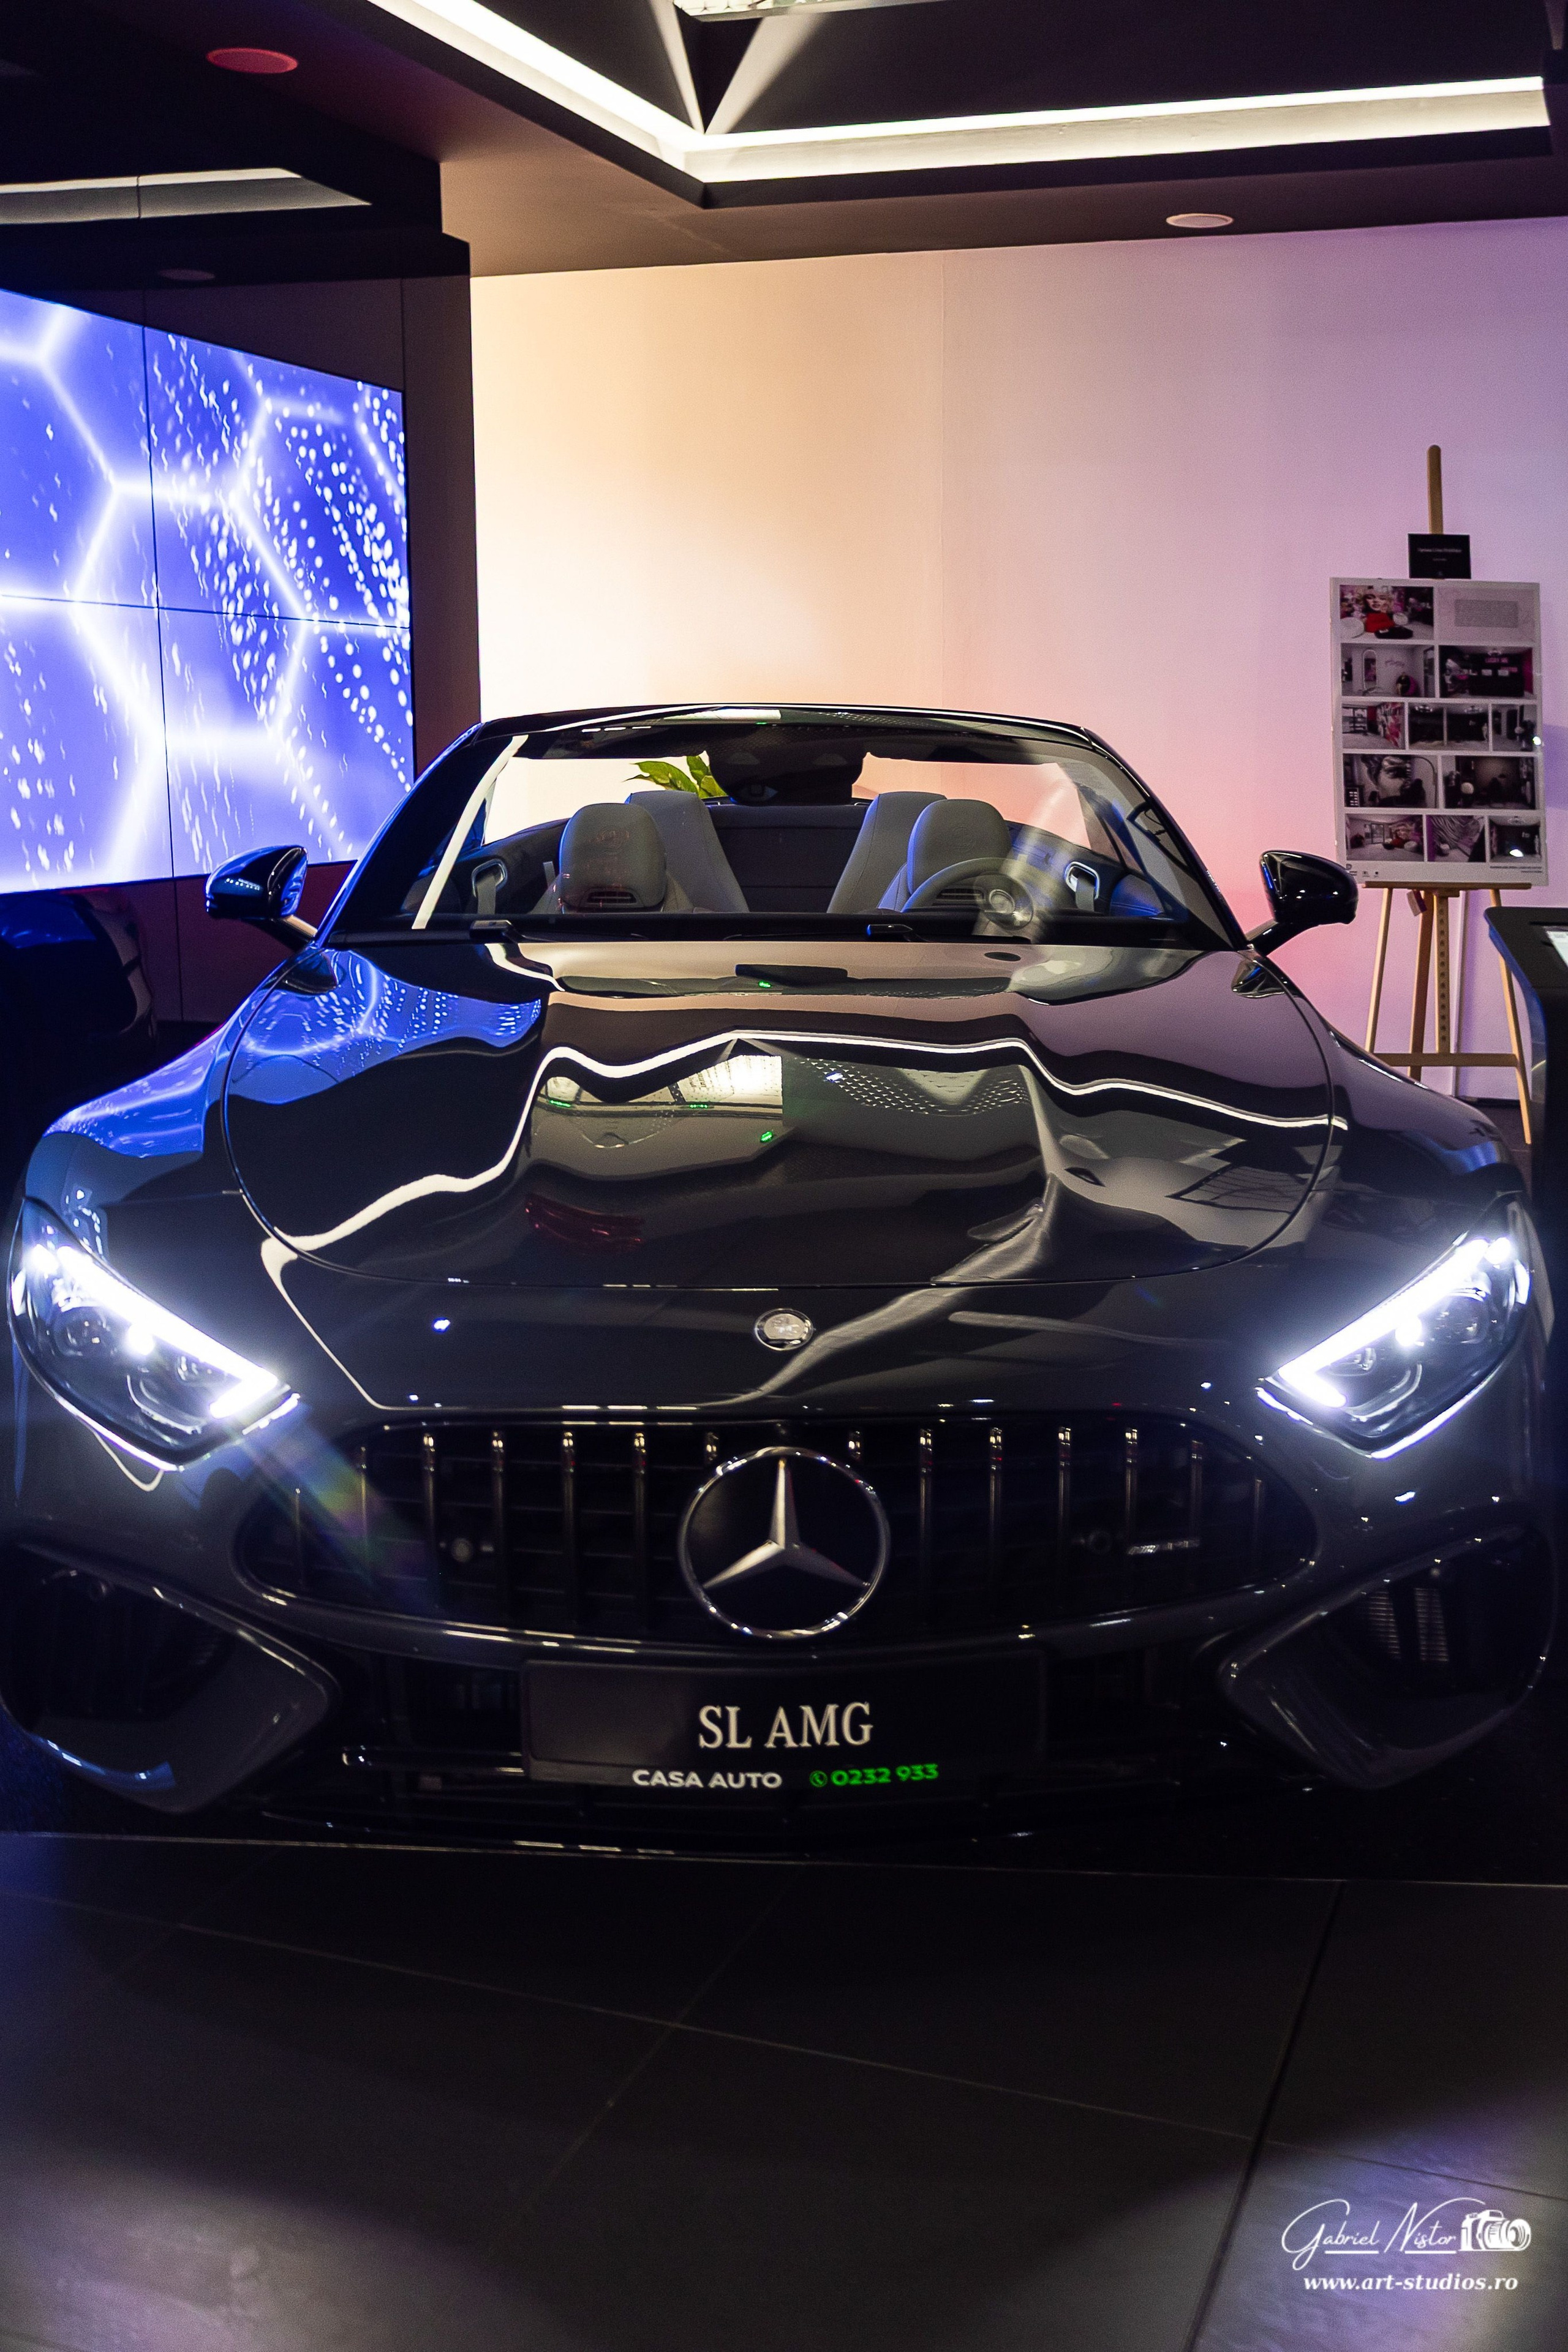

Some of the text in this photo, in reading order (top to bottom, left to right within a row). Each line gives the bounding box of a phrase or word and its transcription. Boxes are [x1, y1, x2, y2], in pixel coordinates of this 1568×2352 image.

[698, 1701, 874, 1749] SL AMG
[632, 1763, 939, 1789] CASA AUTO 0232 933
